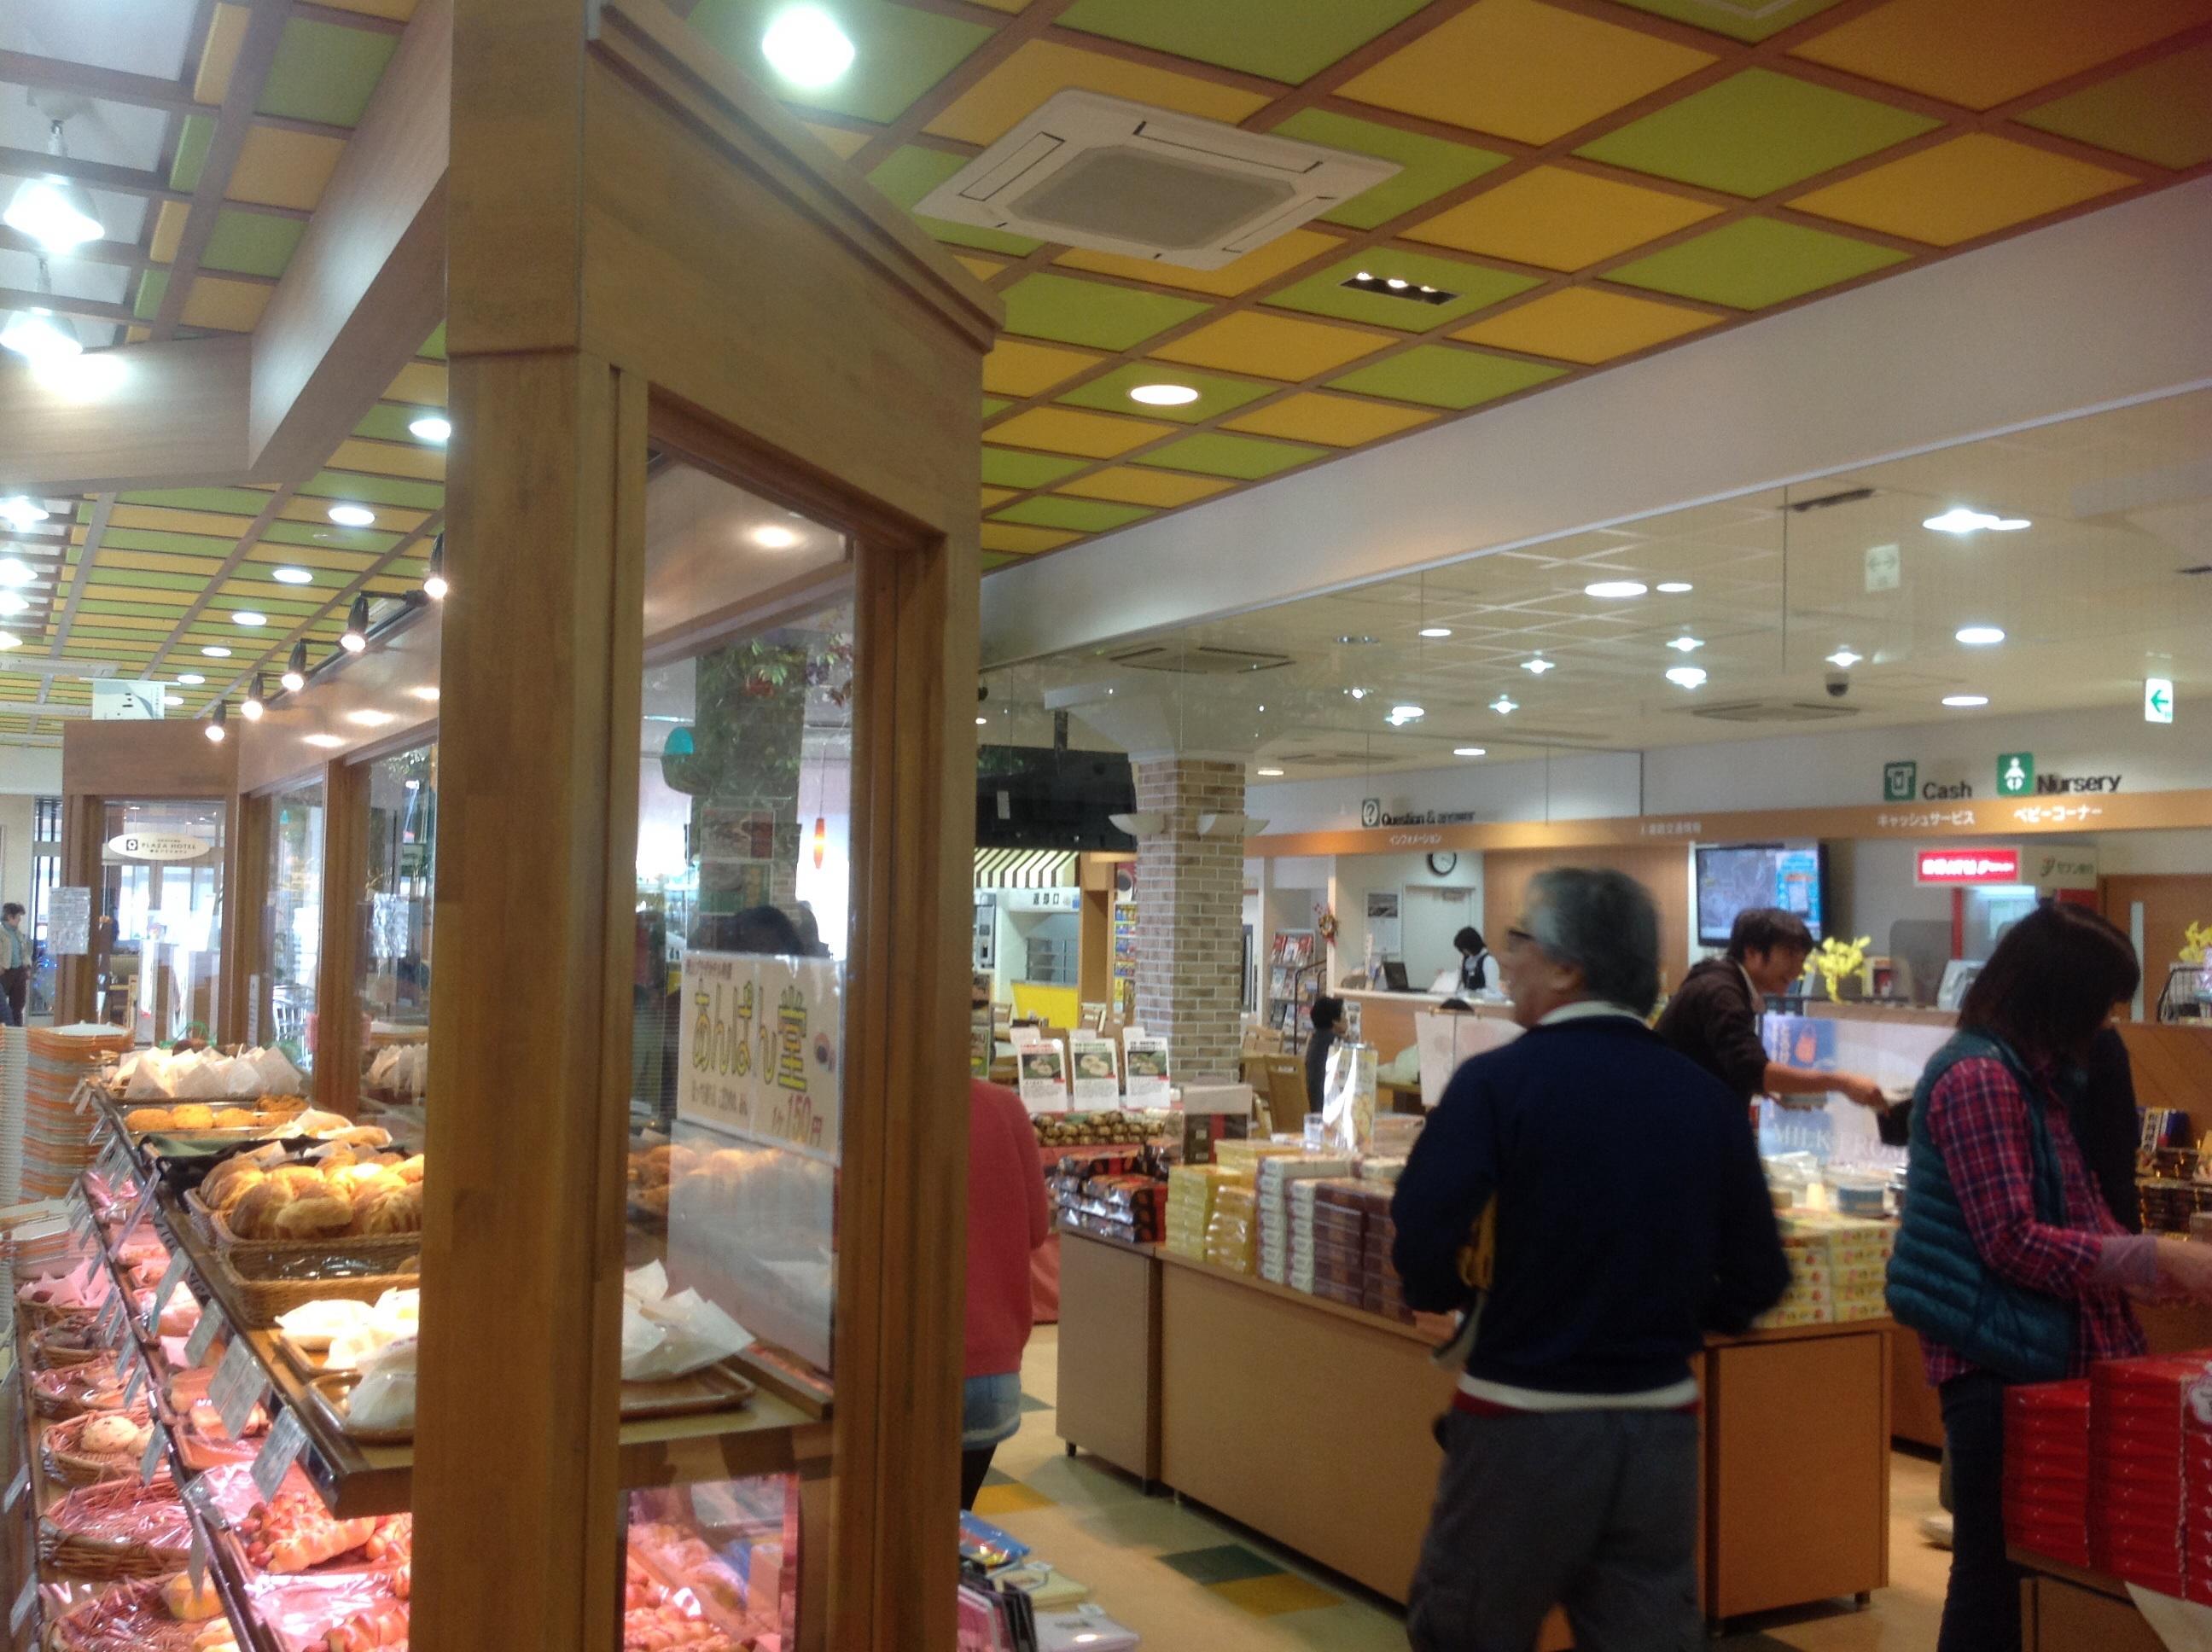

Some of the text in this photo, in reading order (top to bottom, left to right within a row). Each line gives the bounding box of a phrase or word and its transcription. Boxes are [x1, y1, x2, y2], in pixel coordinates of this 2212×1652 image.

[1923, 781, 1972, 800] Cash
[2037, 774, 2122, 794] Nursery
[1877, 809, 1976, 828] キャッシュサービス
[2012, 804, 2103, 823] ベビーコーナー
[1773, 1123, 1831, 1149] MILK
